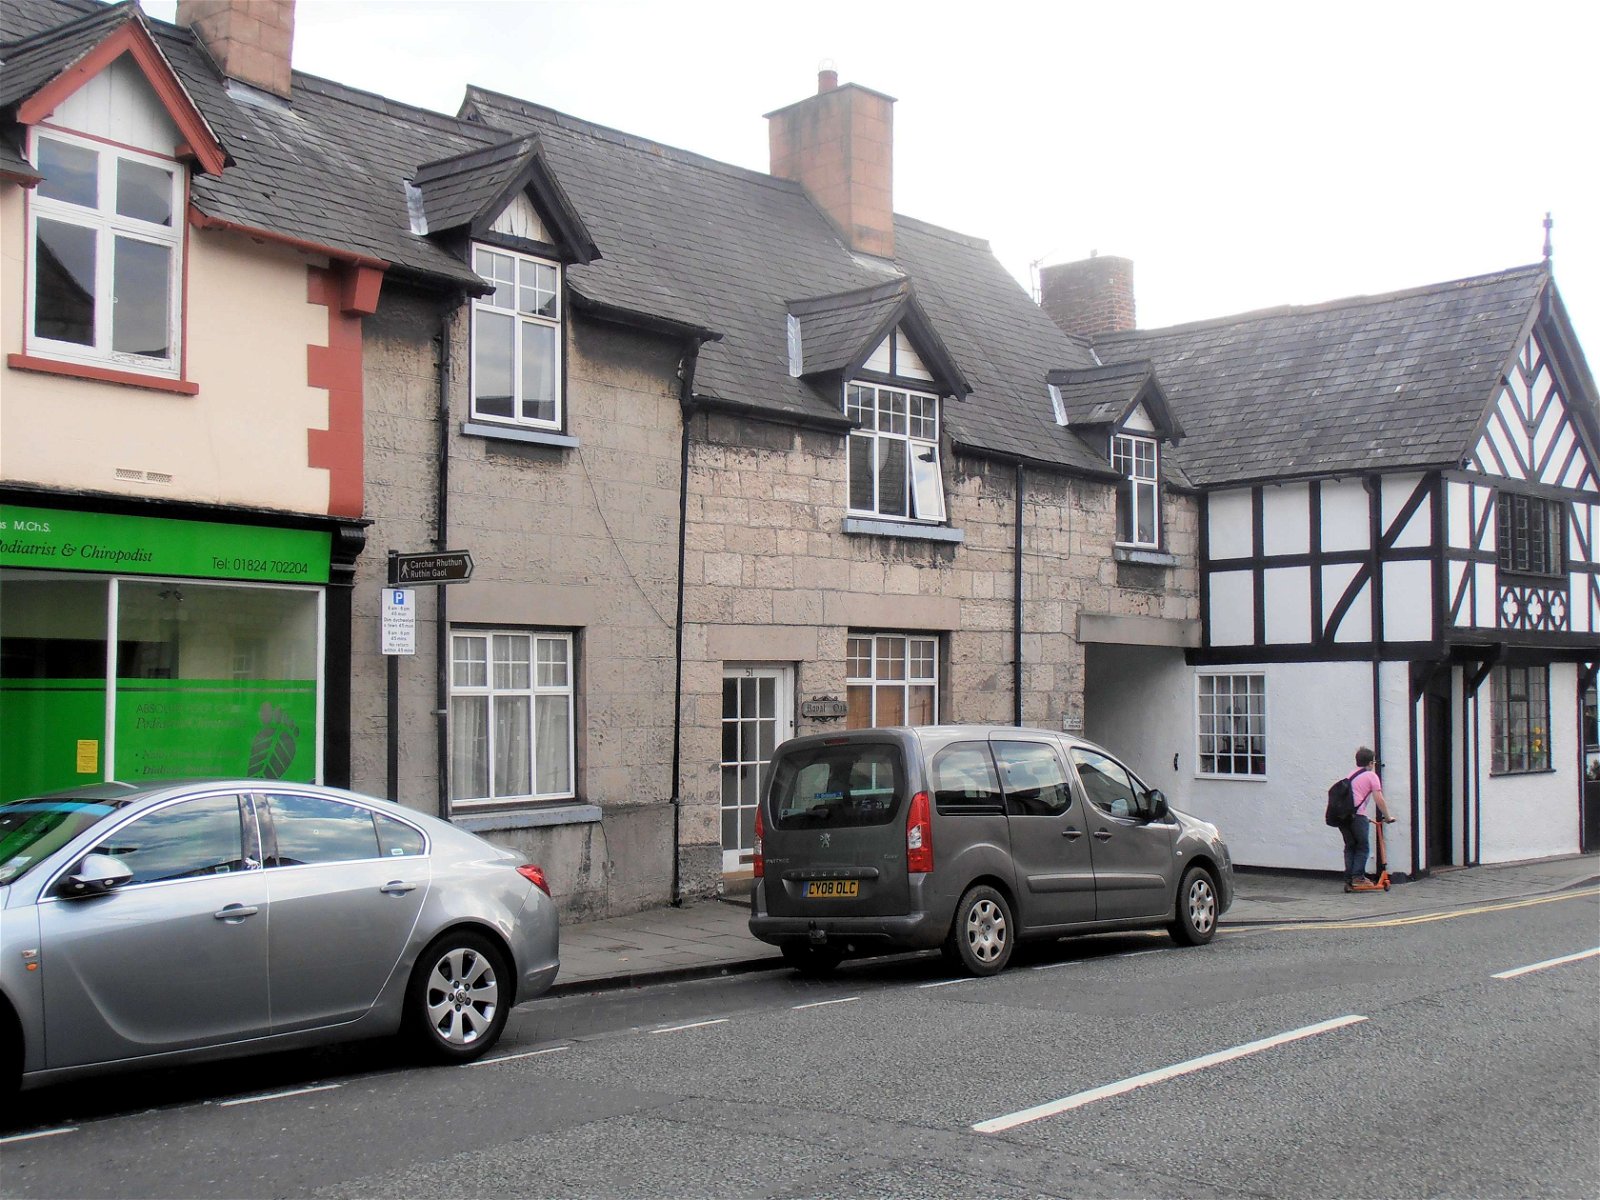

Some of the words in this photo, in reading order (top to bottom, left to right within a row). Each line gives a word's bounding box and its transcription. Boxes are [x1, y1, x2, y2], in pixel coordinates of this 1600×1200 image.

[61, 543, 77, 557] &
[80, 544, 153, 564] Chiropodist
[212, 557, 230, 570] Tel:
[233, 558, 267, 572] 01824
[270, 560, 308, 574] 702204
[410, 560, 435, 569] Carchar
[436, 558, 463, 567] Rhuthun
[410, 569, 431, 578] Ruthin
[432, 568, 448, 577] Gaol
[395, 592, 403, 604] P
[809, 882, 834, 894] CY08
[836, 881, 857, 894] OLC
